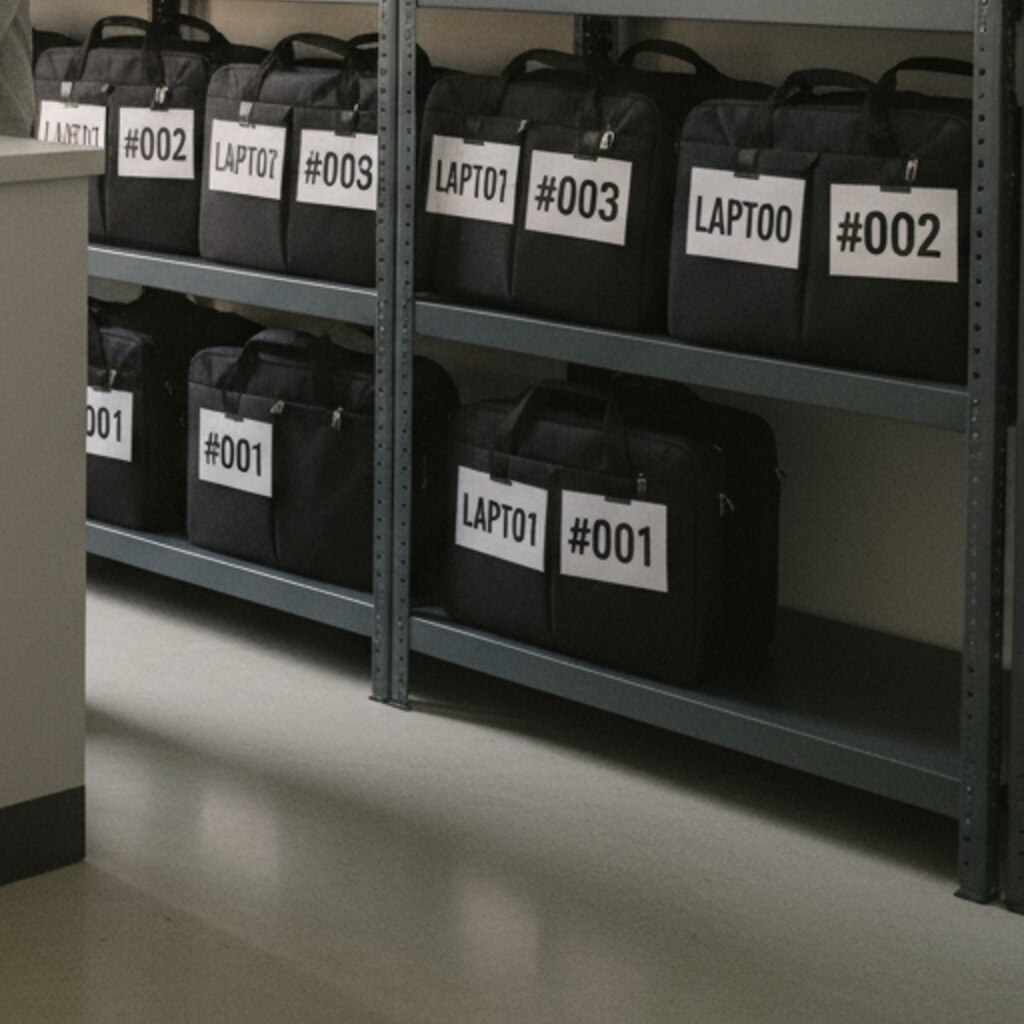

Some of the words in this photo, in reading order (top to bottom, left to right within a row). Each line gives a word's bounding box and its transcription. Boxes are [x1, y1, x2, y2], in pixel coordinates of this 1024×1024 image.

[123, 127, 187, 162] #002
[303, 151, 374, 191] #003
[534, 175, 620, 223] #003
[836, 211, 943, 259] #002
[86, 404, 122, 443] 001
[204, 431, 263, 477] #001
[567, 516, 652, 567] #001
